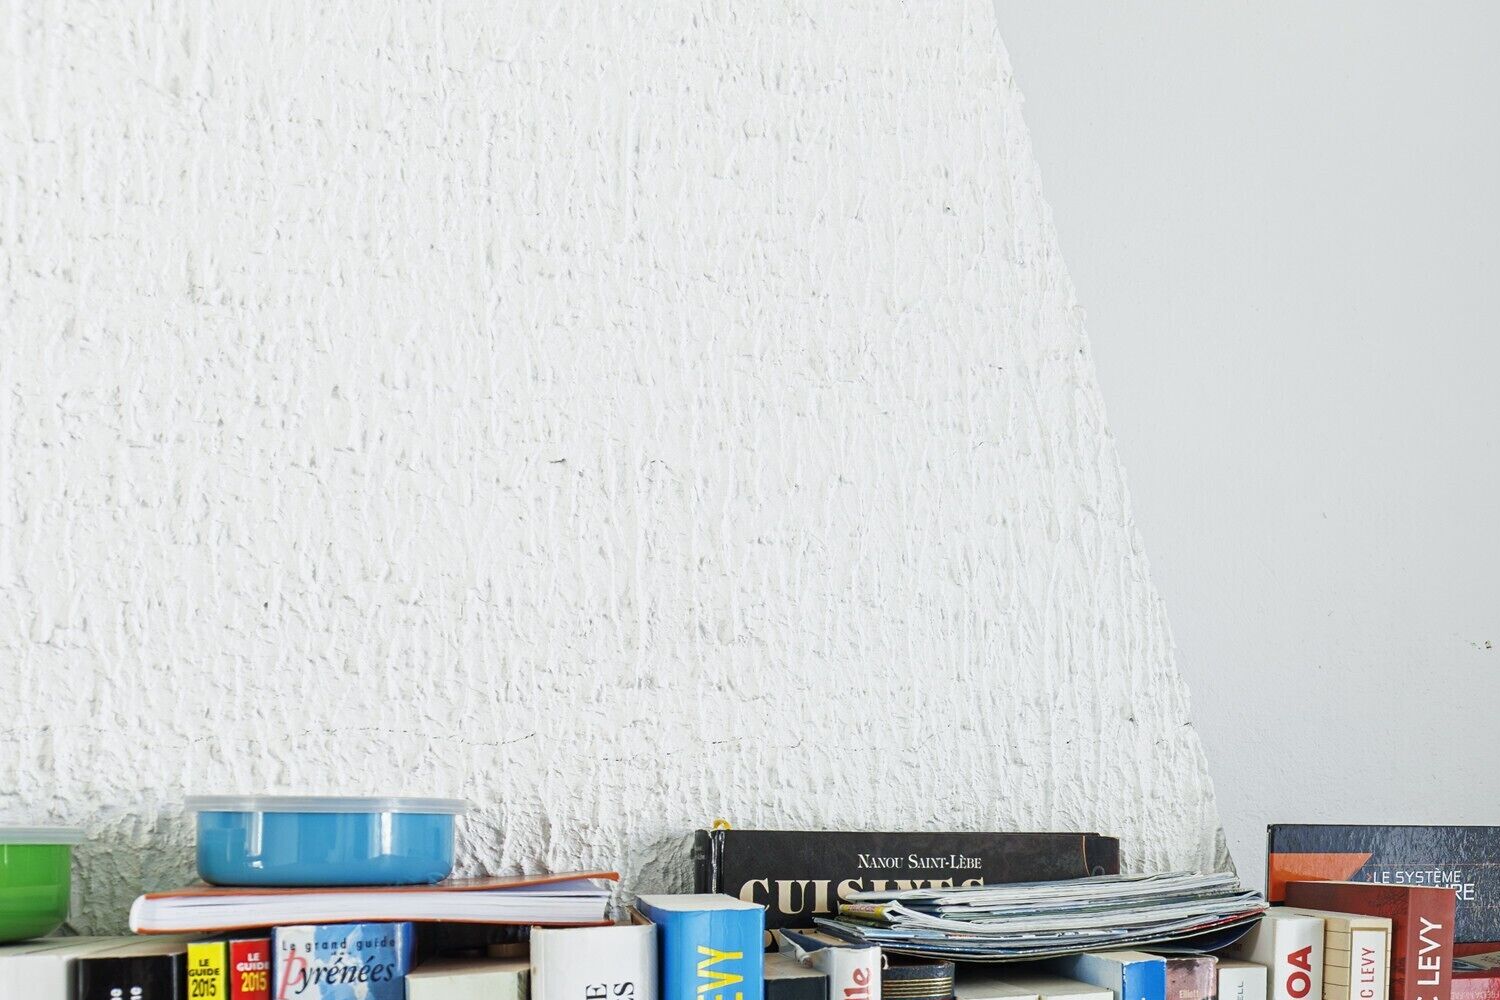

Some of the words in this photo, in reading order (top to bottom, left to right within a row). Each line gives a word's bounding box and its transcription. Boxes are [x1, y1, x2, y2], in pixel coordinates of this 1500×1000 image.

[858, 853, 904, 870] NANOU
[908, 852, 982, 870] SAINT-LÈBE
[1373, 871, 1390, 884] LE
[1395, 867, 1461, 884] SYSTÈME
[305, 938, 348, 953] grand
[356, 937, 397, 950] guide
[1417, 917, 1443, 986] LEVY
[188, 966, 220, 978] GUIDE
[236, 960, 271, 972] GUIDE
[1360, 947, 1375, 983] LEVY
[191, 977, 217, 998] 2015
[240, 970, 267, 993] 2015
